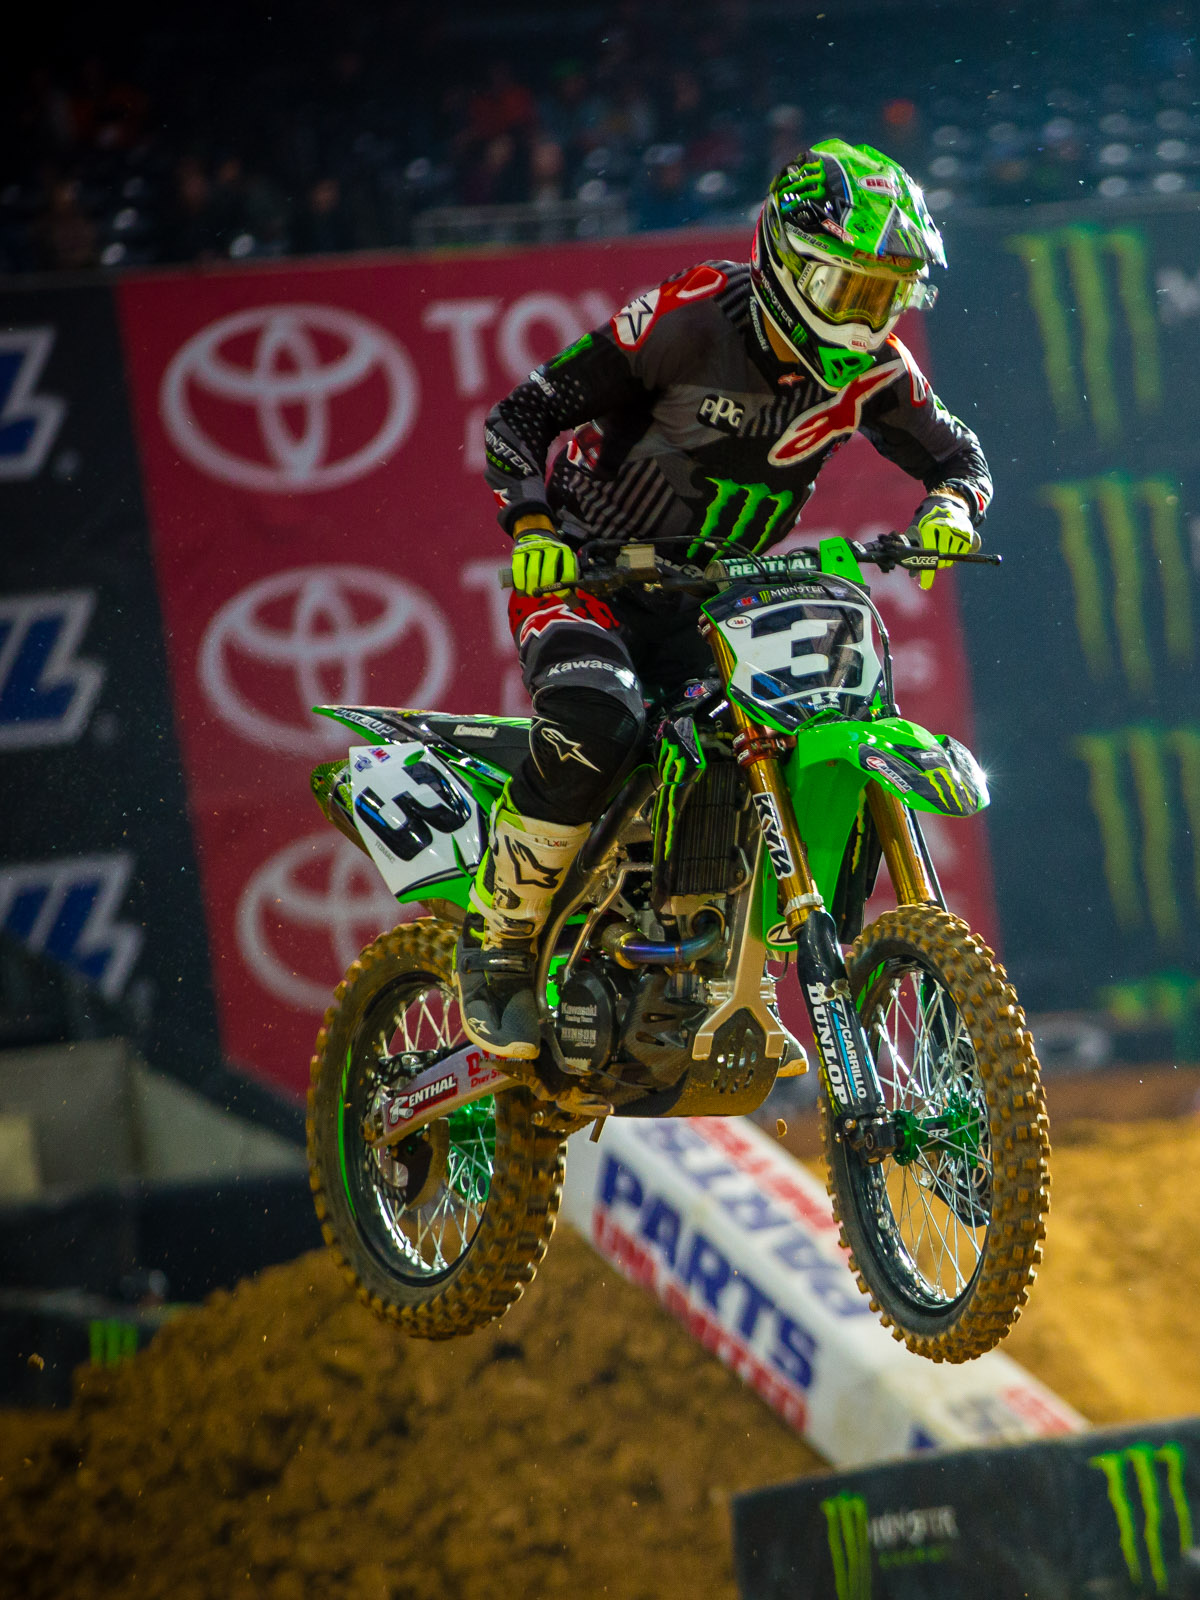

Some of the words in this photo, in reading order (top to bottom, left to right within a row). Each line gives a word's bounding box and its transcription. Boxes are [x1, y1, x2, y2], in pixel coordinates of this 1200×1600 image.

[851, 339, 867, 349] BELL
[770, 584, 826, 598] MONSTER
[901, 555, 939, 566] ARC
[750, 602, 865, 700] 3
[354, 761, 472, 862] 3
[806, 983, 849, 1105] DUNLOP
[841, 1029, 867, 1099] CARRILLO
[389, 1075, 457, 1125] RENTHAL
[598, 1154, 818, 1391] PARTS
